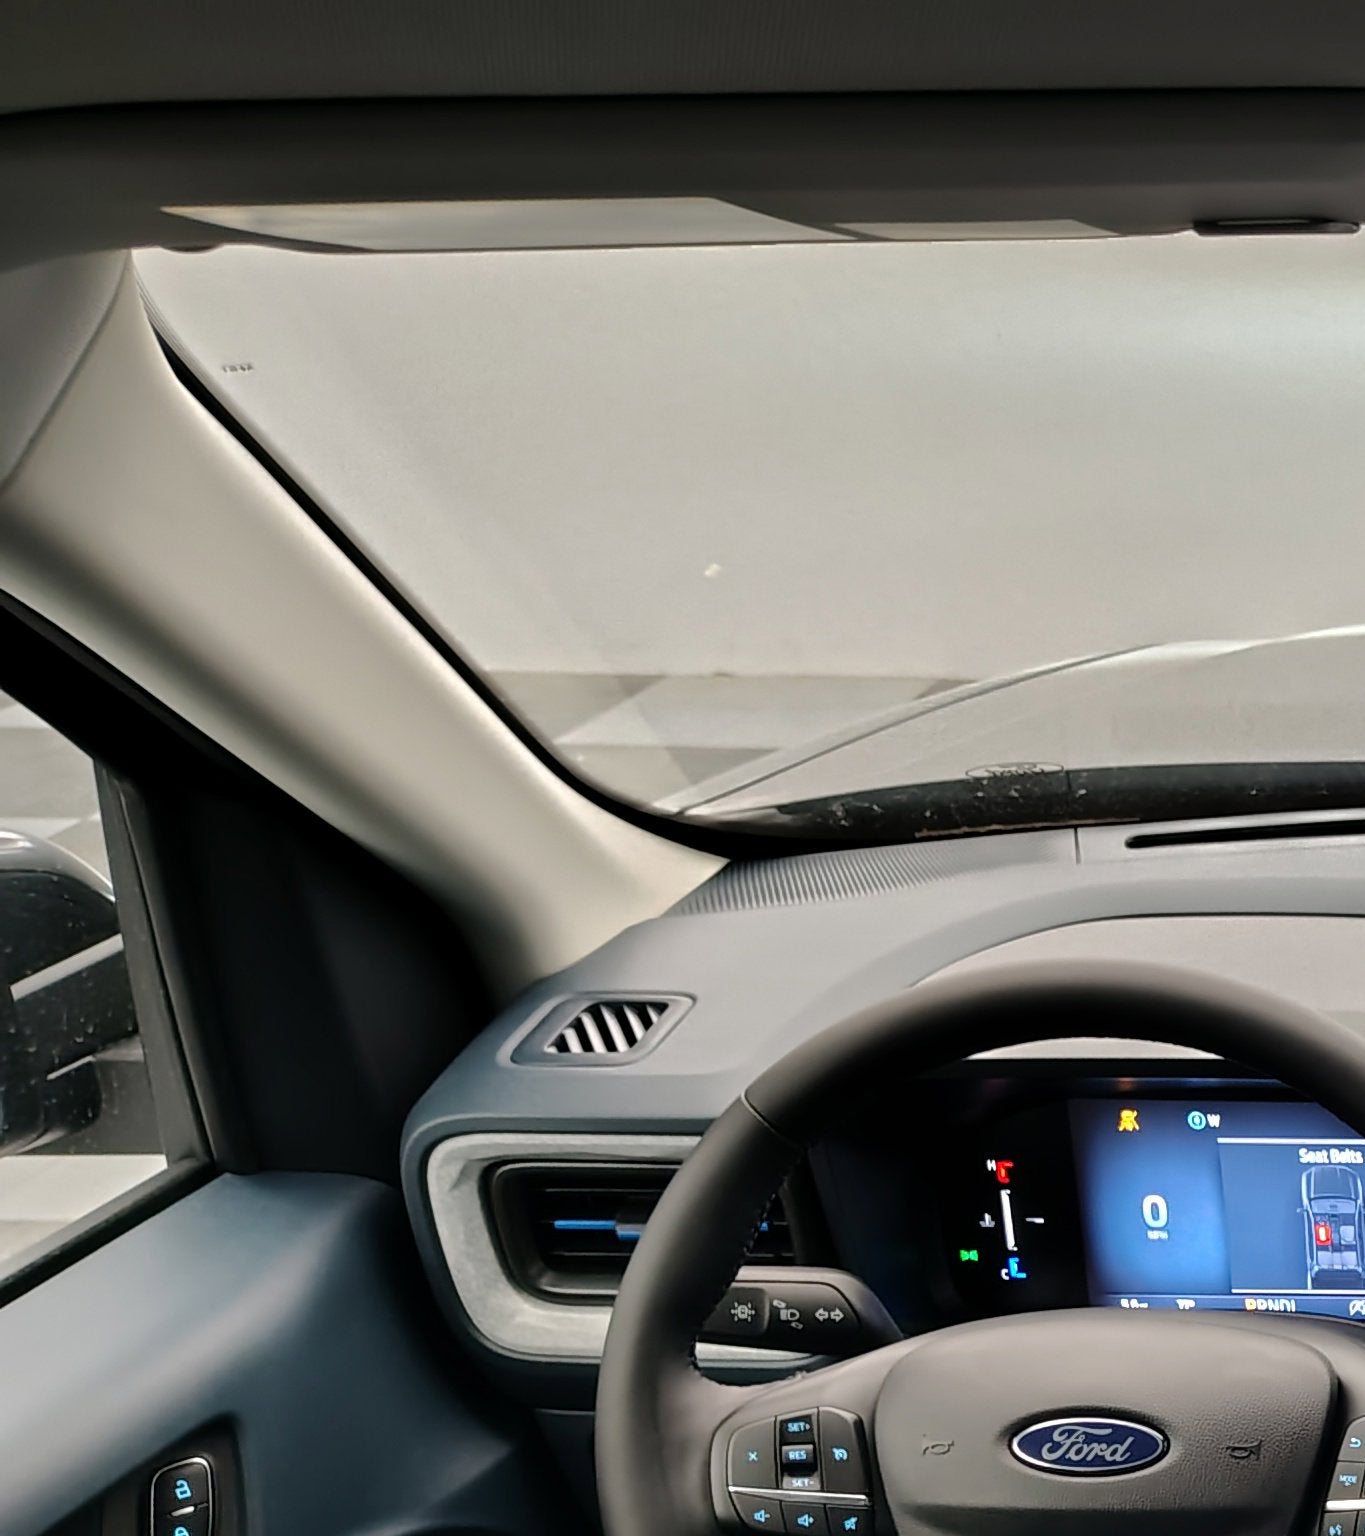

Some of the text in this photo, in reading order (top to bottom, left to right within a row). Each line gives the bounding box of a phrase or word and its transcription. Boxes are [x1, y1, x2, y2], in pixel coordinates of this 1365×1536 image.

[1298, 1147, 1364, 1164] Seat Belts
[1142, 1194, 1168, 1228] 0
[1041, 1425, 1135, 1462] Ford
[788, 1451, 807, 1461] RES
[1339, 1474, 1358, 1484] MODE
